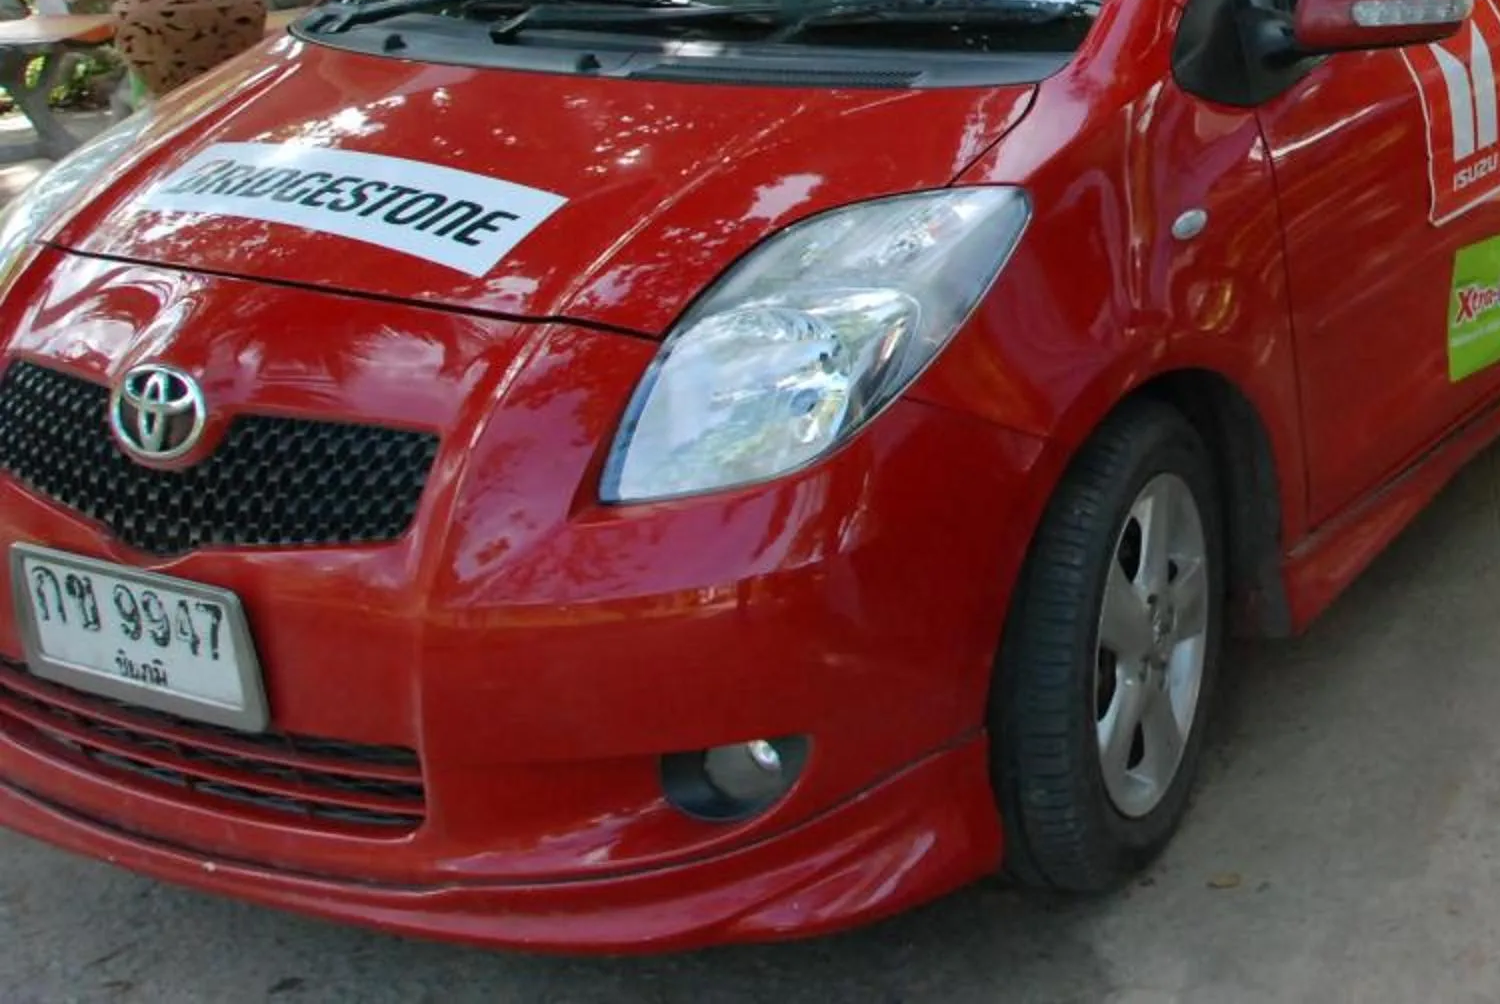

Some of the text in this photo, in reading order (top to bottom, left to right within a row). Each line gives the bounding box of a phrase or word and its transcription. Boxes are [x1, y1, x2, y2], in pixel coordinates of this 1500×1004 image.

[164, 159, 520, 247] BRIDGESTONE
[1453, 151, 1499, 193] ISUZU
[113, 584, 223, 661] 9947
